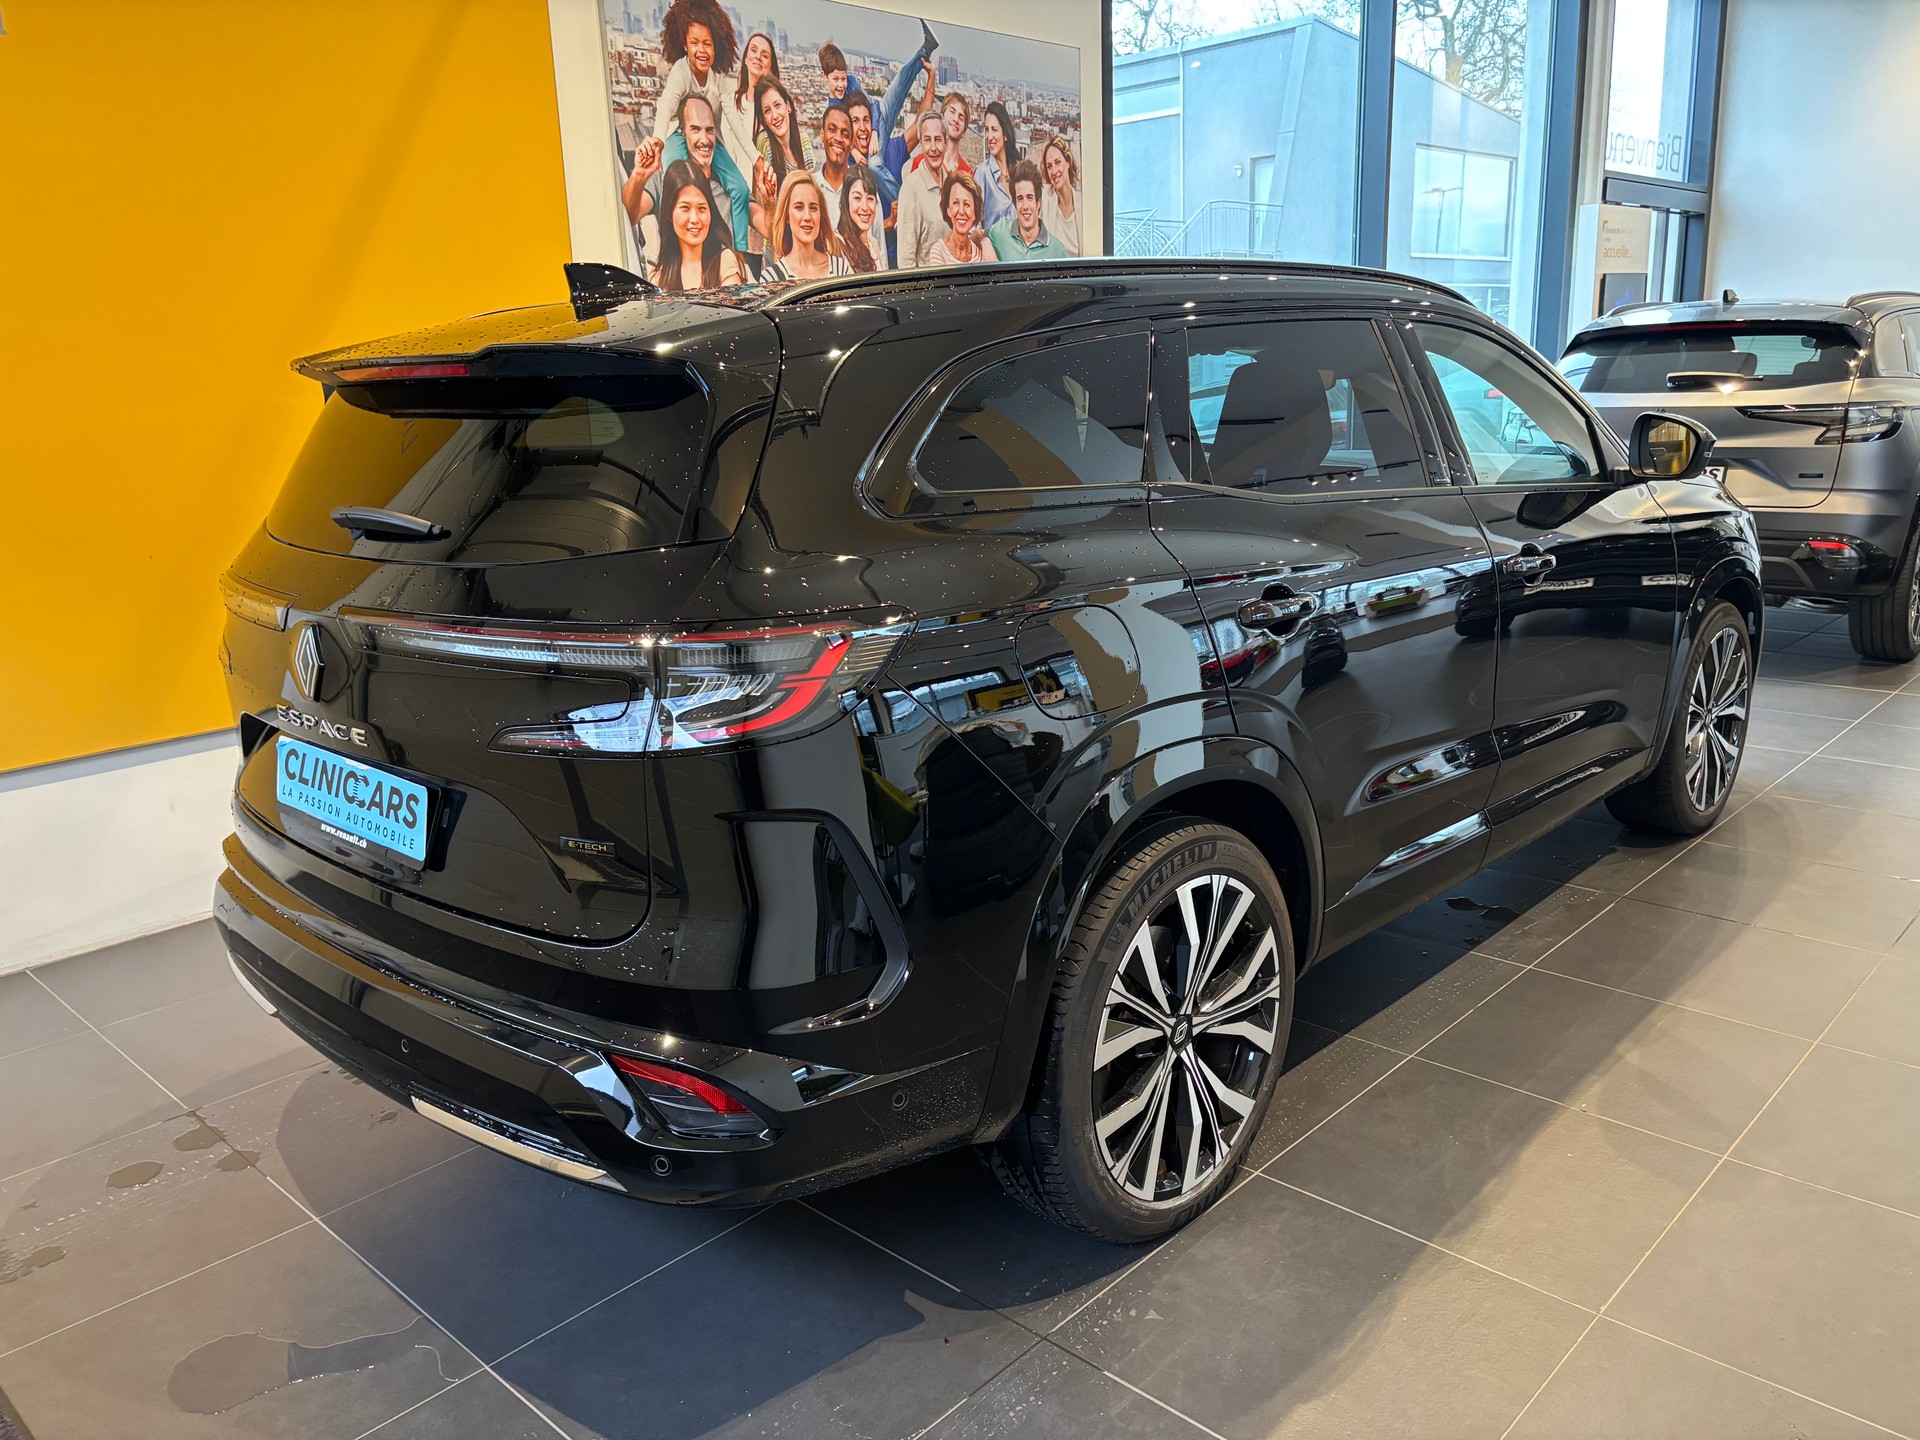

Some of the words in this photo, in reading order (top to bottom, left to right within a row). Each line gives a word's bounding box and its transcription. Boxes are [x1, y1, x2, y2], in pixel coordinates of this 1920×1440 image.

[276, 703, 369, 747] ESPACE
[282, 785, 293, 798] LA
[298, 793, 341, 817] PASSION
[346, 811, 415, 849] AUTOMOBILE
[320, 822, 367, 849] www.renault.ch
[568, 841, 607, 851] E-TECH
[1127, 843, 1213, 920] MICHELIN
